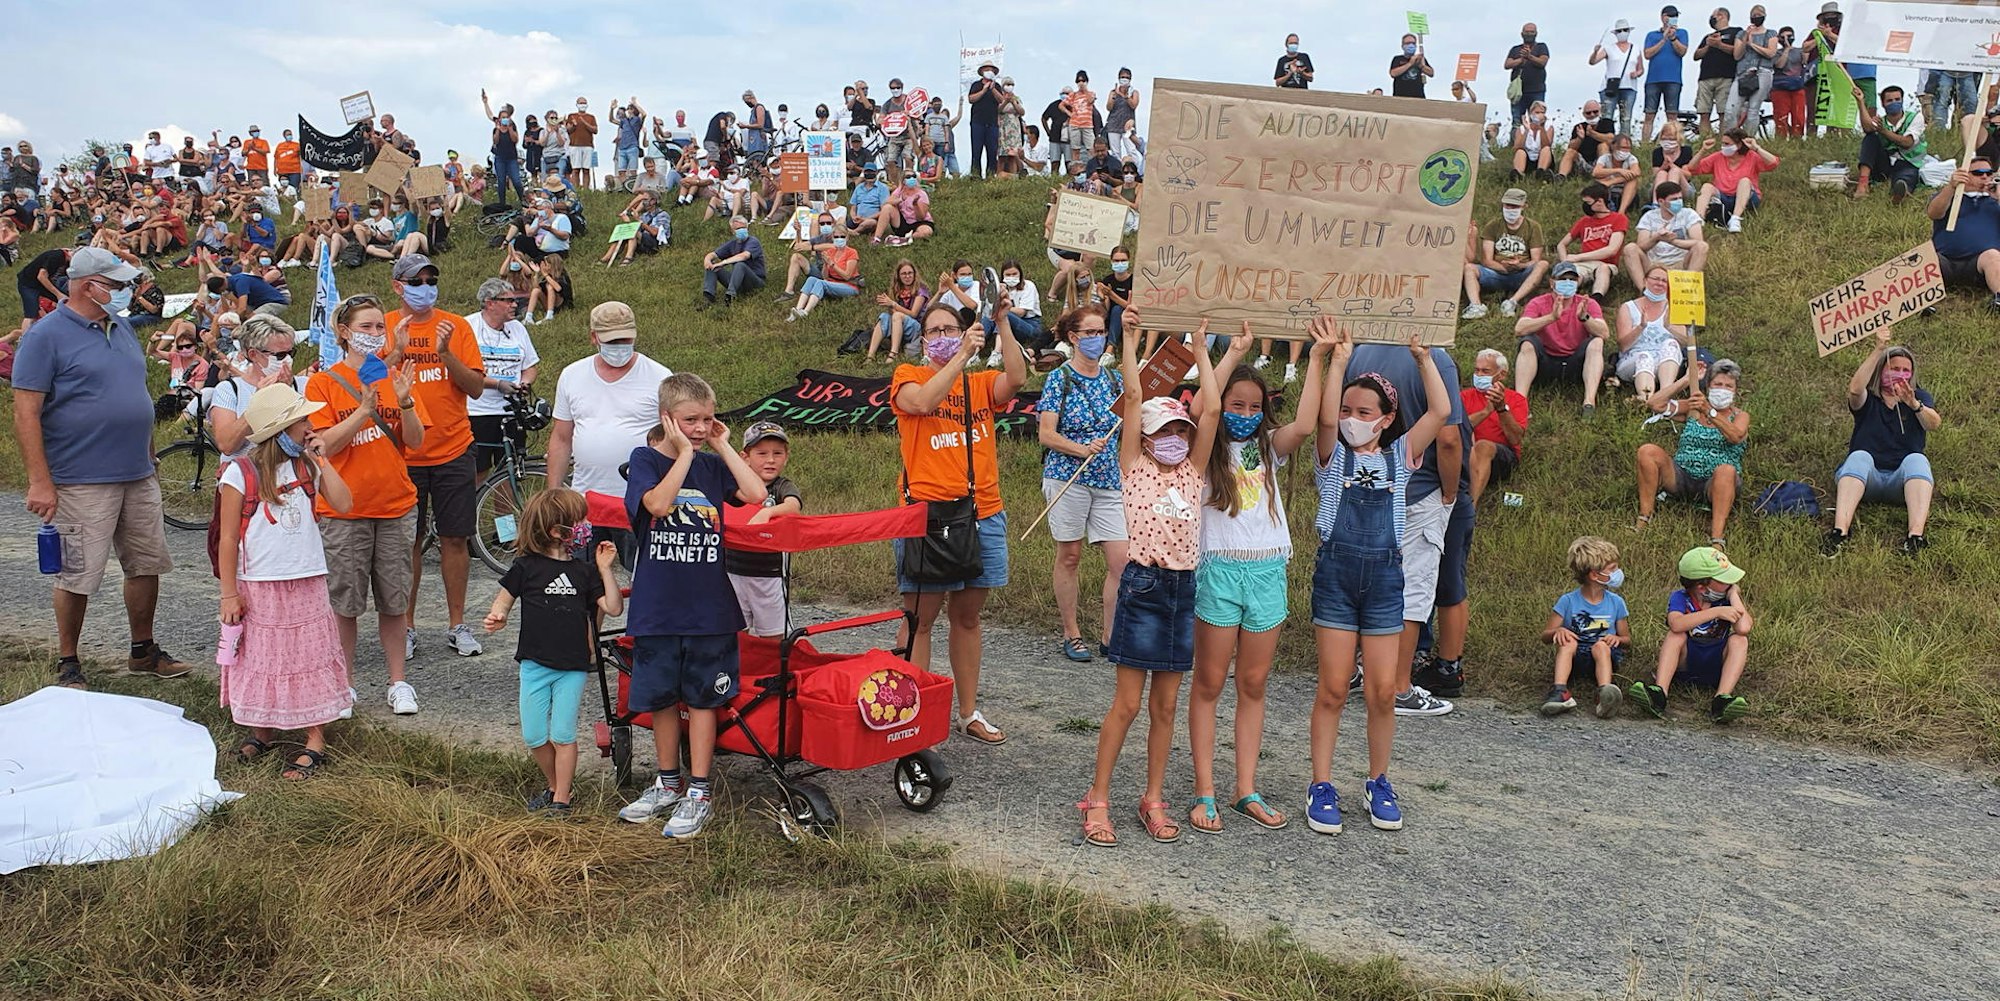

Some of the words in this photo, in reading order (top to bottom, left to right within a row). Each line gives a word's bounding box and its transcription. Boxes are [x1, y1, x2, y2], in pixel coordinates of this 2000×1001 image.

[1904, 14, 1944, 23] Vernetzung
[1945, 15, 1968, 24] Kölner
[1176, 101, 1234, 141] DIE
[1258, 112, 1389, 141] AUTOBAHN
[1166, 155, 1200, 168] STOP
[809, 171, 842, 179] ASTER
[1216, 155, 1417, 194] ZERSTÖRT
[1168, 200, 1222, 236] DIE
[1245, 206, 1392, 248] UMWELT
[1406, 223, 1456, 249] UND
[1194, 259, 1303, 301] UNSERE
[1313, 272, 1430, 301] ZUKUNFT
[1142, 287, 1190, 307] STOP
[1811, 280, 1867, 316] MEHR
[1820, 263, 1940, 334] FAHRRÄDER
[1820, 310, 1893, 350] WENIGER
[1898, 283, 1944, 317] AUTOS
[1358, 320, 1387, 338] STOP
[419, 370, 442, 383] UNS
[946, 394, 966, 408] EUE
[930, 431, 959, 451] OHNE
[650, 530, 686, 546] THERE
[689, 532, 701, 546] IS
[703, 533, 720, 546] NO
[649, 544, 704, 562] PLANET
[706, 547, 718, 562] B
[544, 585, 577, 596] adidas
[886, 728, 915, 743] FUXTEC
